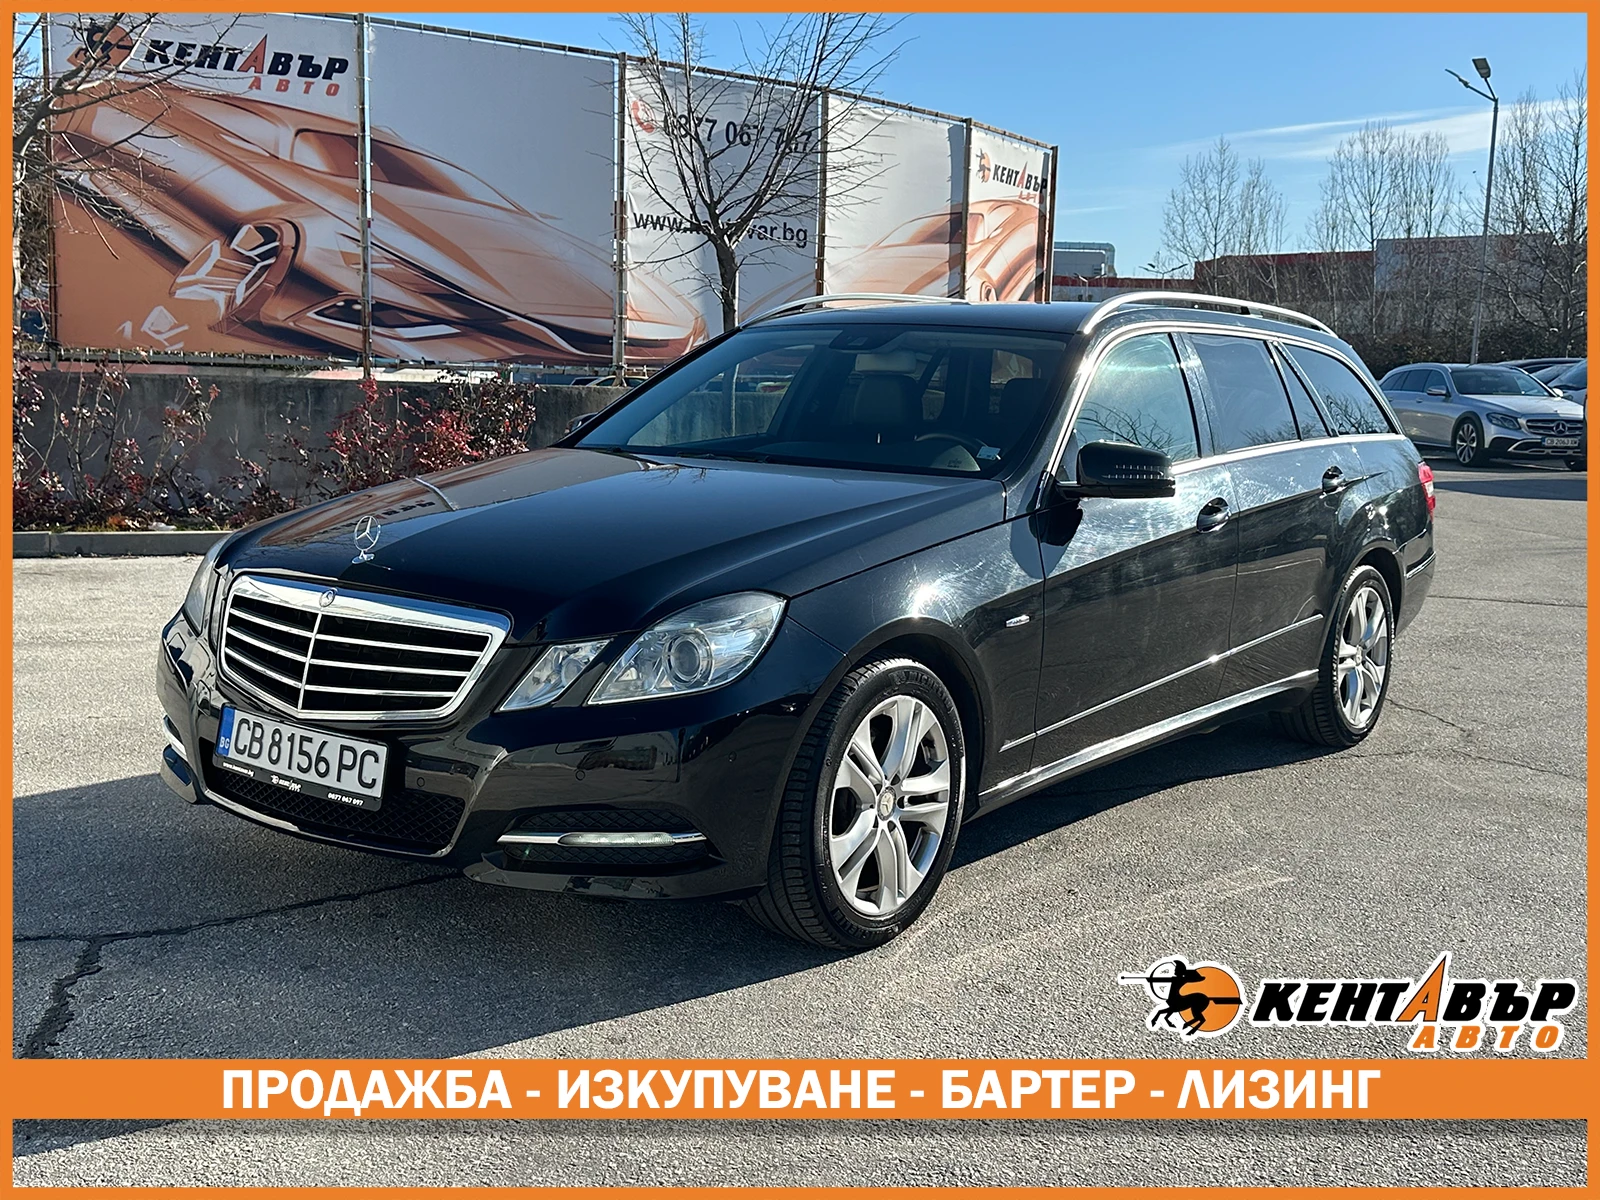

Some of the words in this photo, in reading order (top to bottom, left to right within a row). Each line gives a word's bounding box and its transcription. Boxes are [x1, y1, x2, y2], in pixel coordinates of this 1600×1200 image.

[145, 34, 349, 80] КЕНТАВЪР
[248, 76, 340, 97] АВТО
[992, 161, 1048, 194] КЕНТАВЪР
[218, 736, 231, 748] BG
